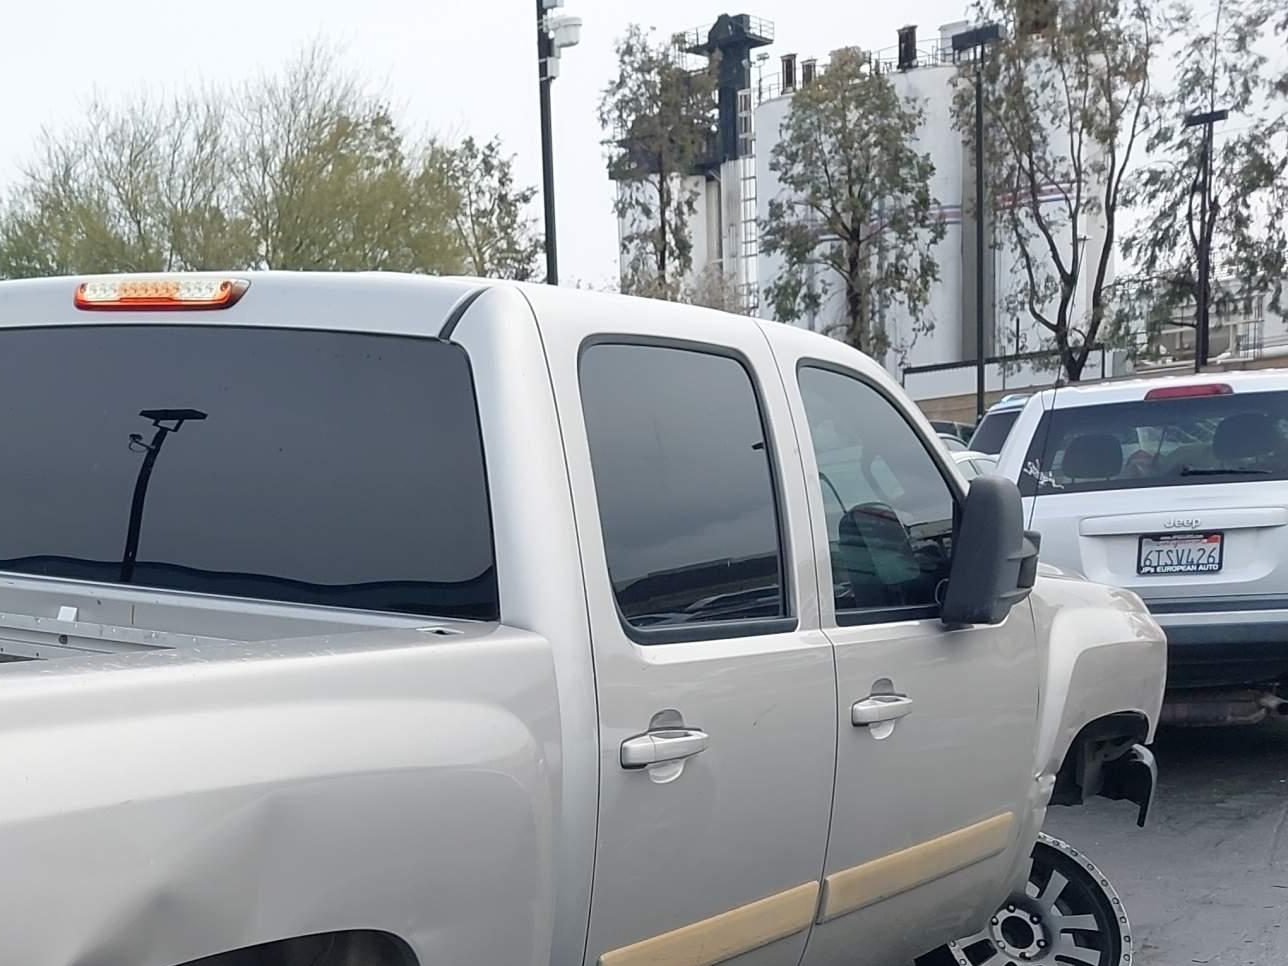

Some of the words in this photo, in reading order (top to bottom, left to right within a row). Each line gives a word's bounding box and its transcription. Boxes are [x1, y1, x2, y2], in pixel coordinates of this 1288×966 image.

[1164, 516, 1201, 529] Jeep
[1156, 565, 1197, 573] EUROPEAN
[1198, 563, 1219, 571] AUTO
